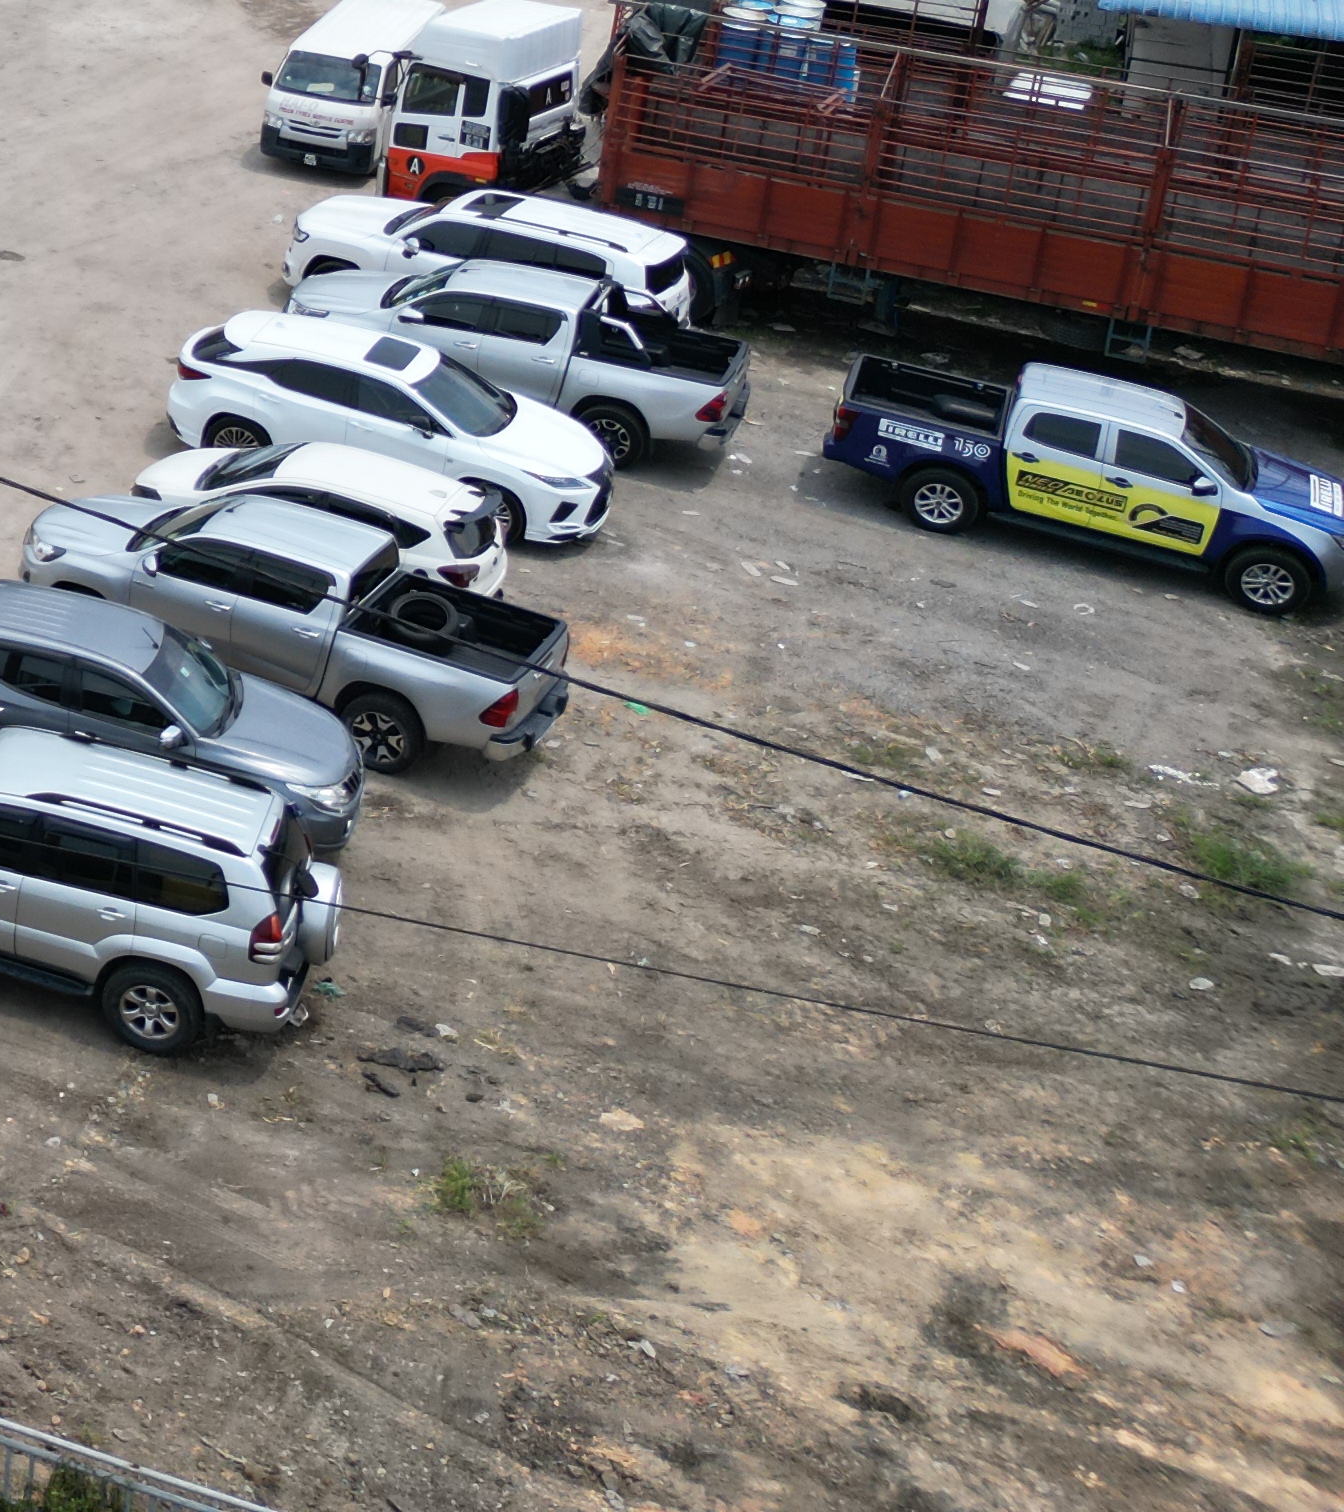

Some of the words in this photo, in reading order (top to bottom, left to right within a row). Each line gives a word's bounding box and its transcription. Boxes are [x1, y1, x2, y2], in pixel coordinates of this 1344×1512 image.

[410, 157, 420, 175] A
[878, 418, 945, 446] PIRELLI
[1018, 490, 1043, 504] Driving
[1046, 494, 1060, 506] The
[1062, 500, 1083, 512] World
